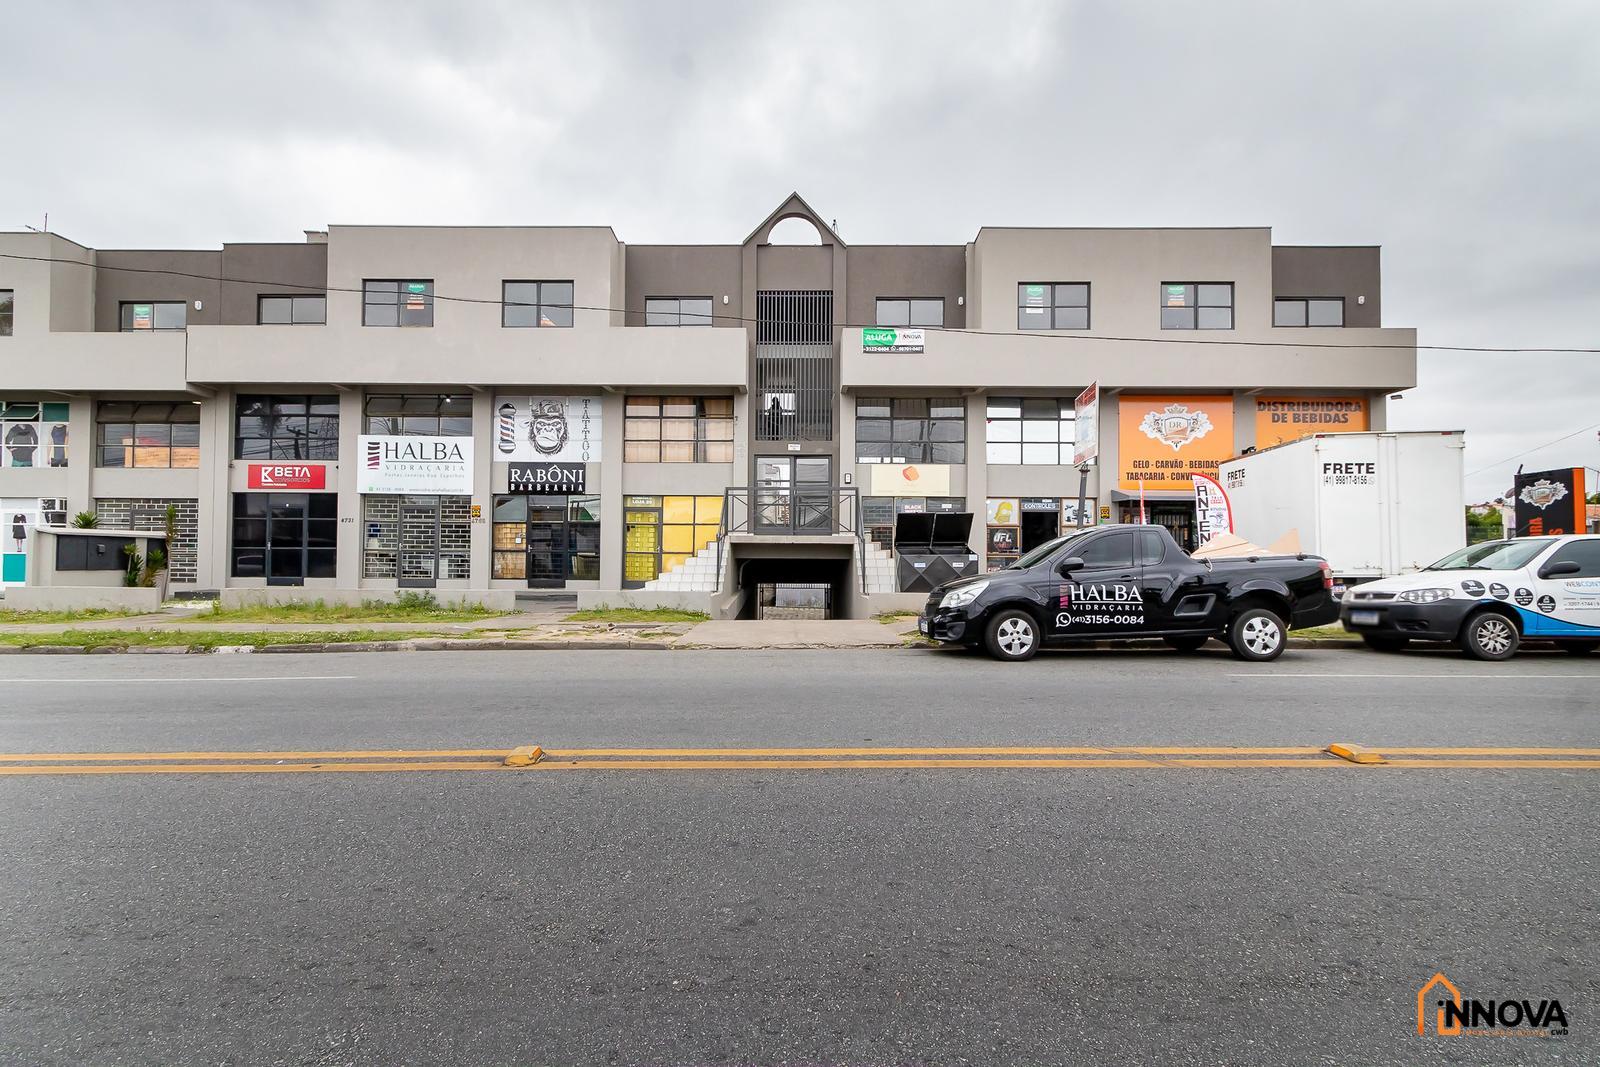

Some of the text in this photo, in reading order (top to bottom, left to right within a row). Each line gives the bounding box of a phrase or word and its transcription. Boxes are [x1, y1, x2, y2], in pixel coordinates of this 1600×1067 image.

[1257, 401, 1362, 412] DISTRIBUIDORA
[1271, 413, 1349, 423] DE BEBIDAS
[581, 399, 591, 461] TATTOO
[384, 441, 464, 460] HALBA
[385, 464, 465, 472] VIDRAÇARIA
[1133, 459, 1219, 468] GELO CARVÃO BEBIDAS
[1323, 463, 1375, 474] FRETE
[274, 466, 311, 477] BETA
[510, 464, 584, 483] RABÔNI
[1126, 472, 1164, 480] TABACARIA
[1227, 468, 1246, 482] FRETE
[1196, 485, 1211, 547] ANTEN
[1069, 584, 1143, 601] HALBA
[1072, 604, 1144, 612] VIDRAÇARIA
